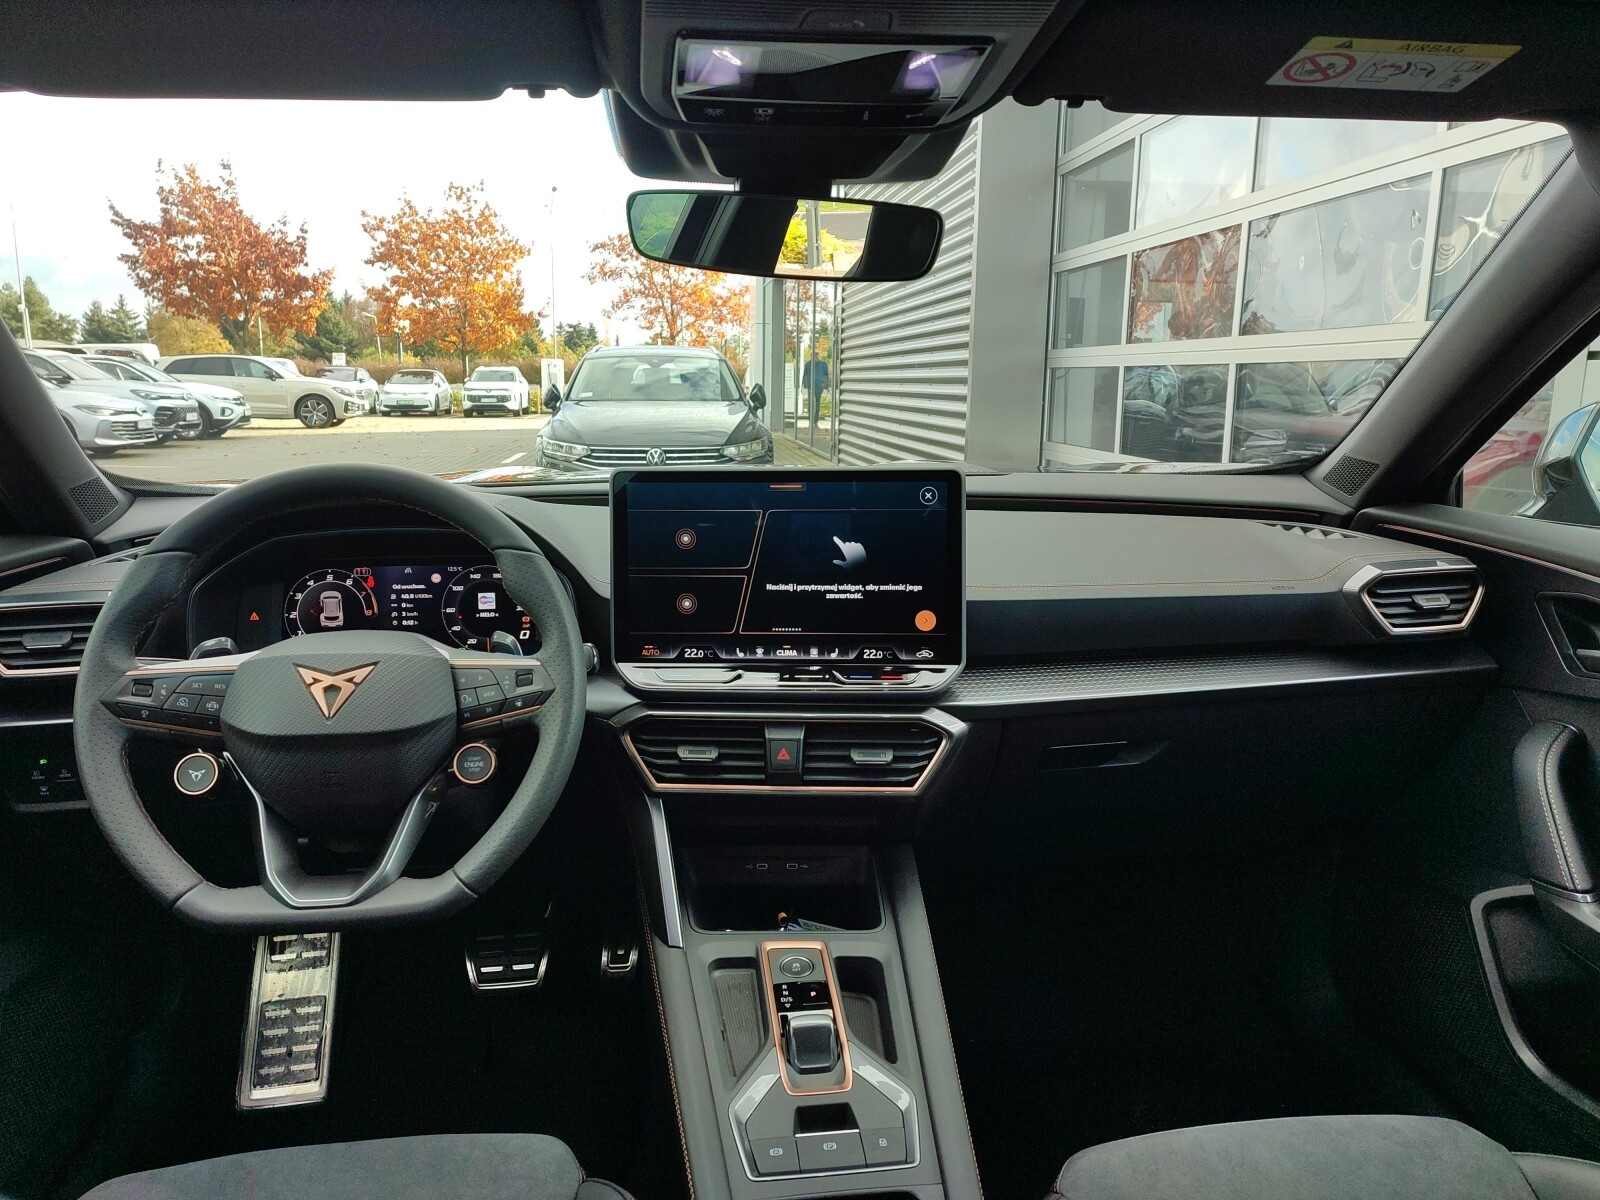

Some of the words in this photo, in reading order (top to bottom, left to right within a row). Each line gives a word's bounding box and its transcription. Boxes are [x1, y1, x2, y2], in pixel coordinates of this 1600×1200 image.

[766, 583, 794, 592] Naciśnij
[797, 583, 838, 592] przytrzymaj
[838, 583, 865, 592] widget,
[865, 584, 879, 592] aby
[879, 583, 906, 591] zmienić
[906, 583, 923, 592] jego
[519, 630, 530, 639] 0
[684, 648, 704, 658] 22.0
[863, 649, 883, 659] 22.0
